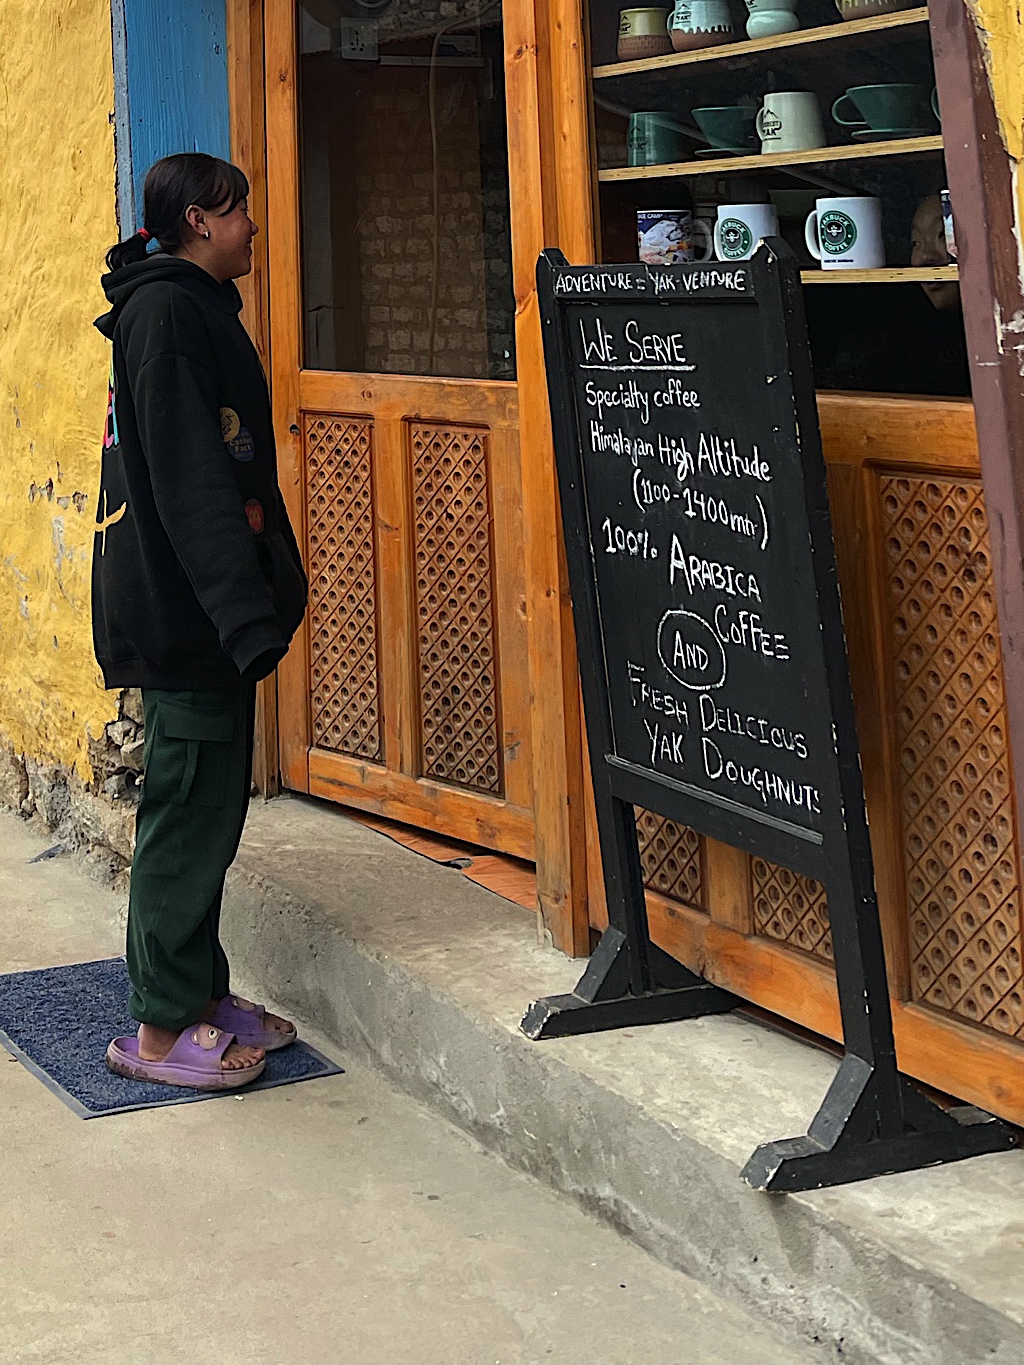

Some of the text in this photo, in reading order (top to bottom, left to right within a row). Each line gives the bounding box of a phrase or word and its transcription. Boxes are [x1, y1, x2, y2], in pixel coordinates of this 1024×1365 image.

[821, 214, 850, 228] YAKBUCK
[824, 241, 848, 252] COFFEE
[555, 272, 634, 293] ADVENTURE
[649, 270, 747, 295] YAK-VENTURE
[626, 320, 687, 363] SERVE
[585, 378, 701, 424] Specialty coffee
[590, 419, 773, 482] Himalayan High Altitude
[602, 517, 658, 559] 100%
[670, 533, 763, 603] ARABICA
[674, 630, 710, 671] AND
[714, 604, 791, 660] COFFEE
[643, 718, 684, 767] YAK
